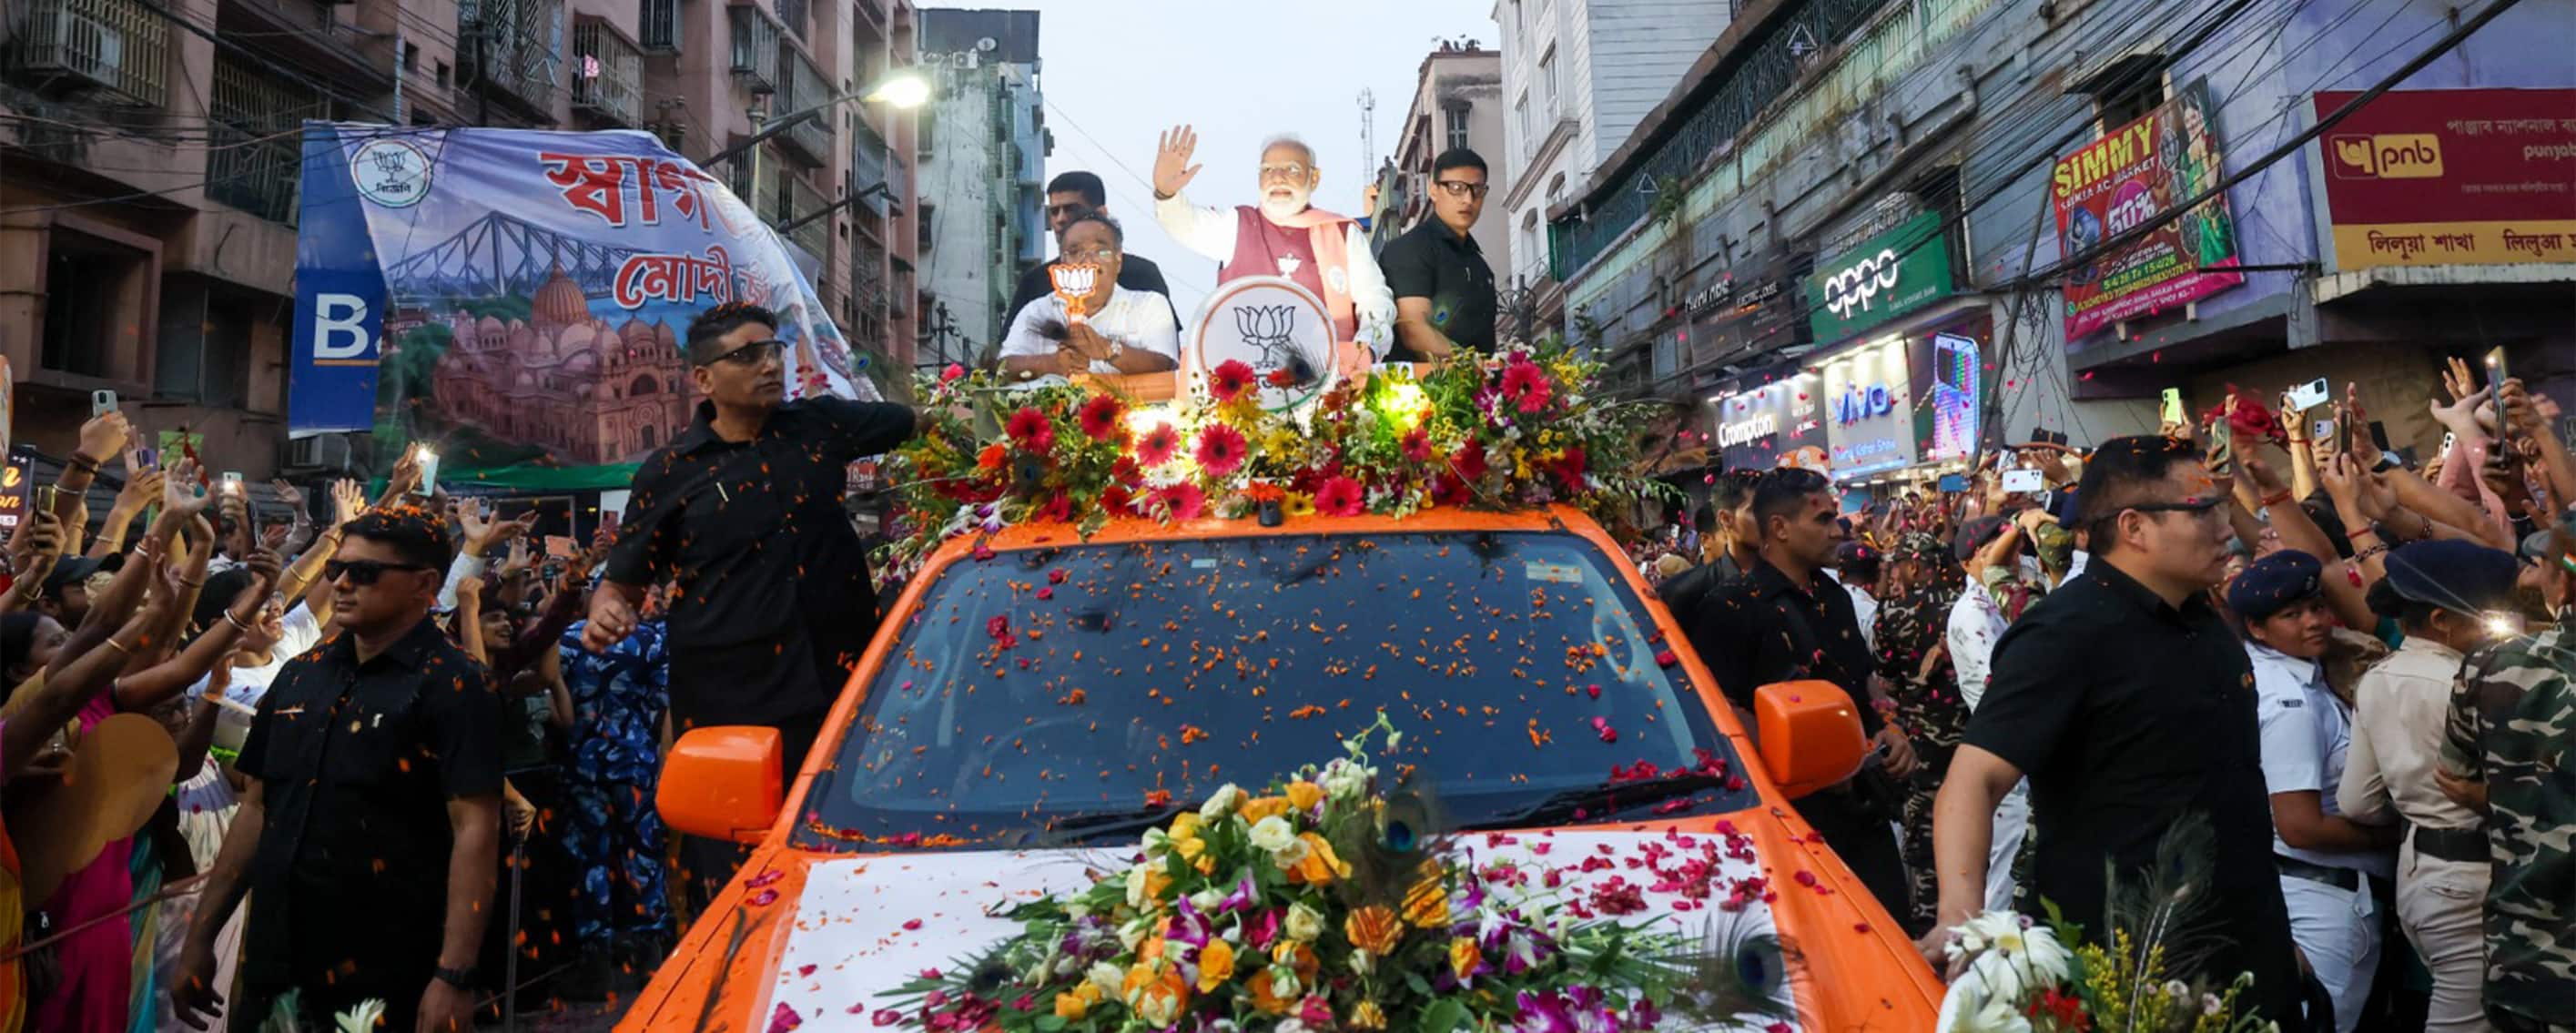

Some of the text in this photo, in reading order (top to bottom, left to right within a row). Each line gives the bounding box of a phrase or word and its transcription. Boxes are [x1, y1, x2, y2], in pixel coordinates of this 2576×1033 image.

[2054, 116, 2155, 197] SIMMY
[2379, 139, 2436, 172] pnb
[2108, 189, 2155, 237] 50%
[2368, 229, 2475, 258] লিলুয়া শাখা
[1825, 248, 1898, 319] oppo
[313, 293, 381, 359] B
[1831, 380, 1892, 425] vivo
[1719, 412, 1775, 449] Crompton
